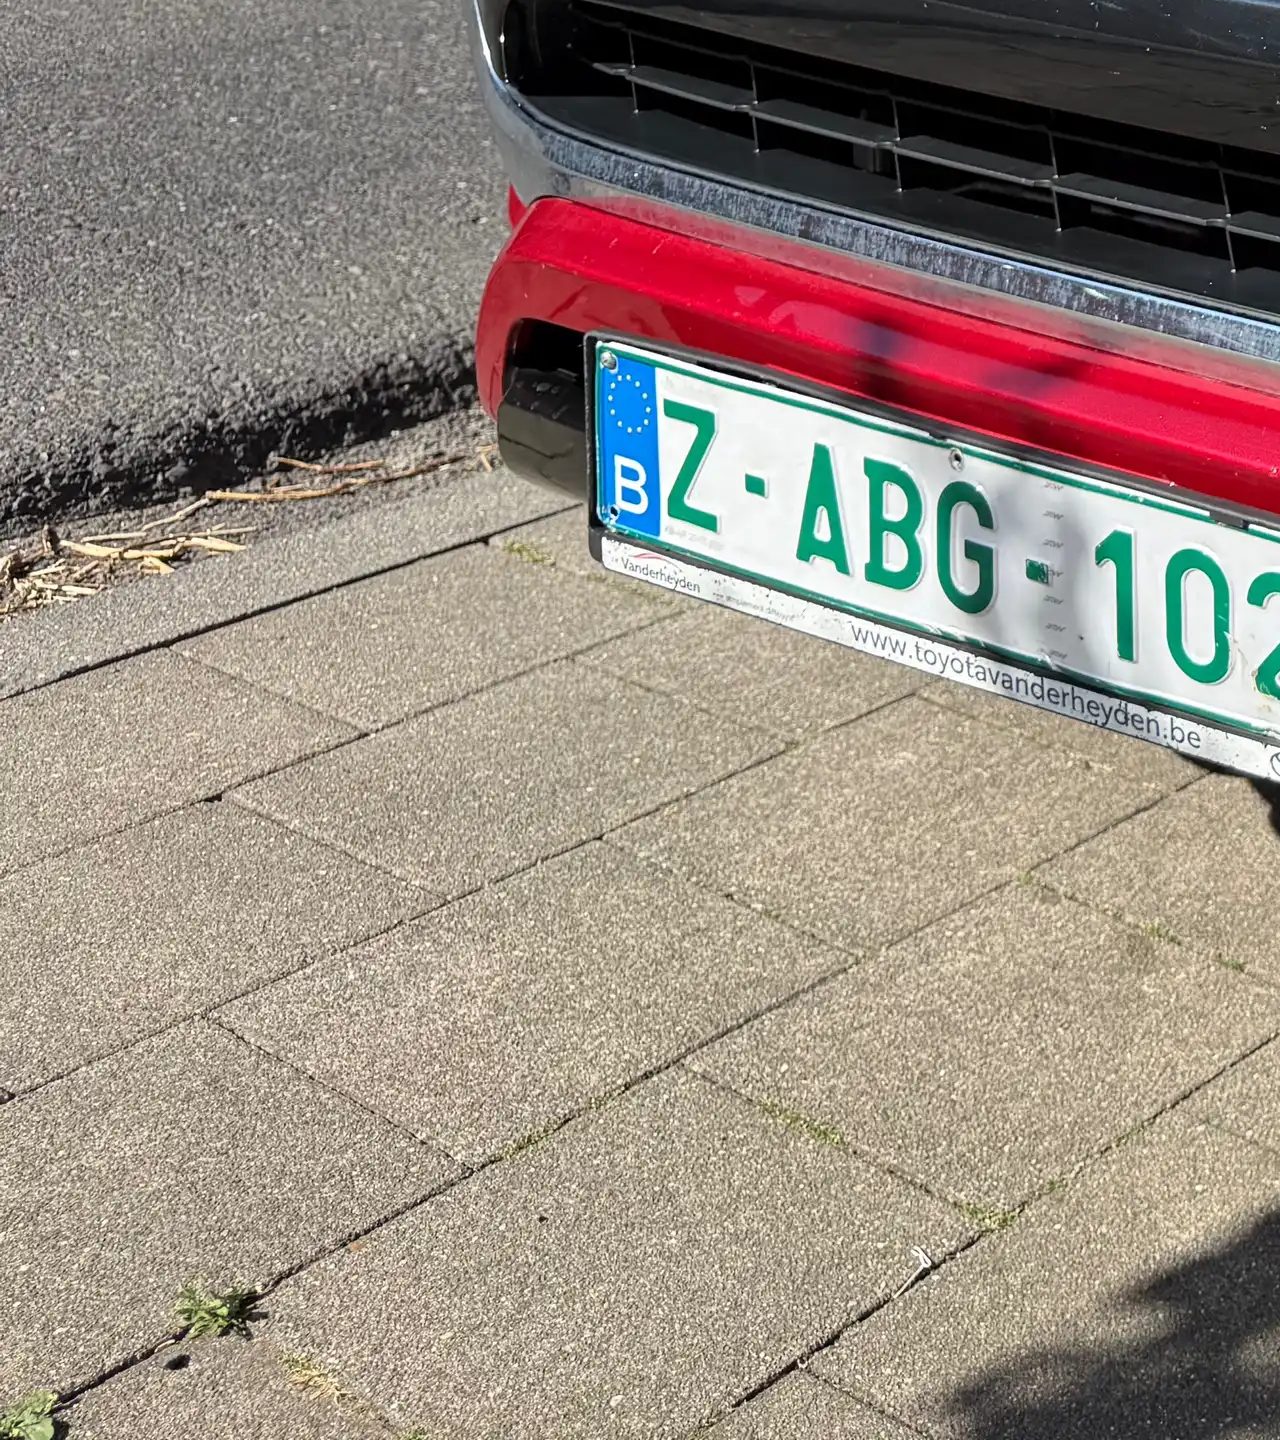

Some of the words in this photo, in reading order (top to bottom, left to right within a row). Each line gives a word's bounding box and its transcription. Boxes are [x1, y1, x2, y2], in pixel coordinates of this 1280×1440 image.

[614, 455, 648, 515] B
[620, 556, 701, 594] Vanderheyden
[850, 622, 1202, 750] www.toyotavanderheyden.be
